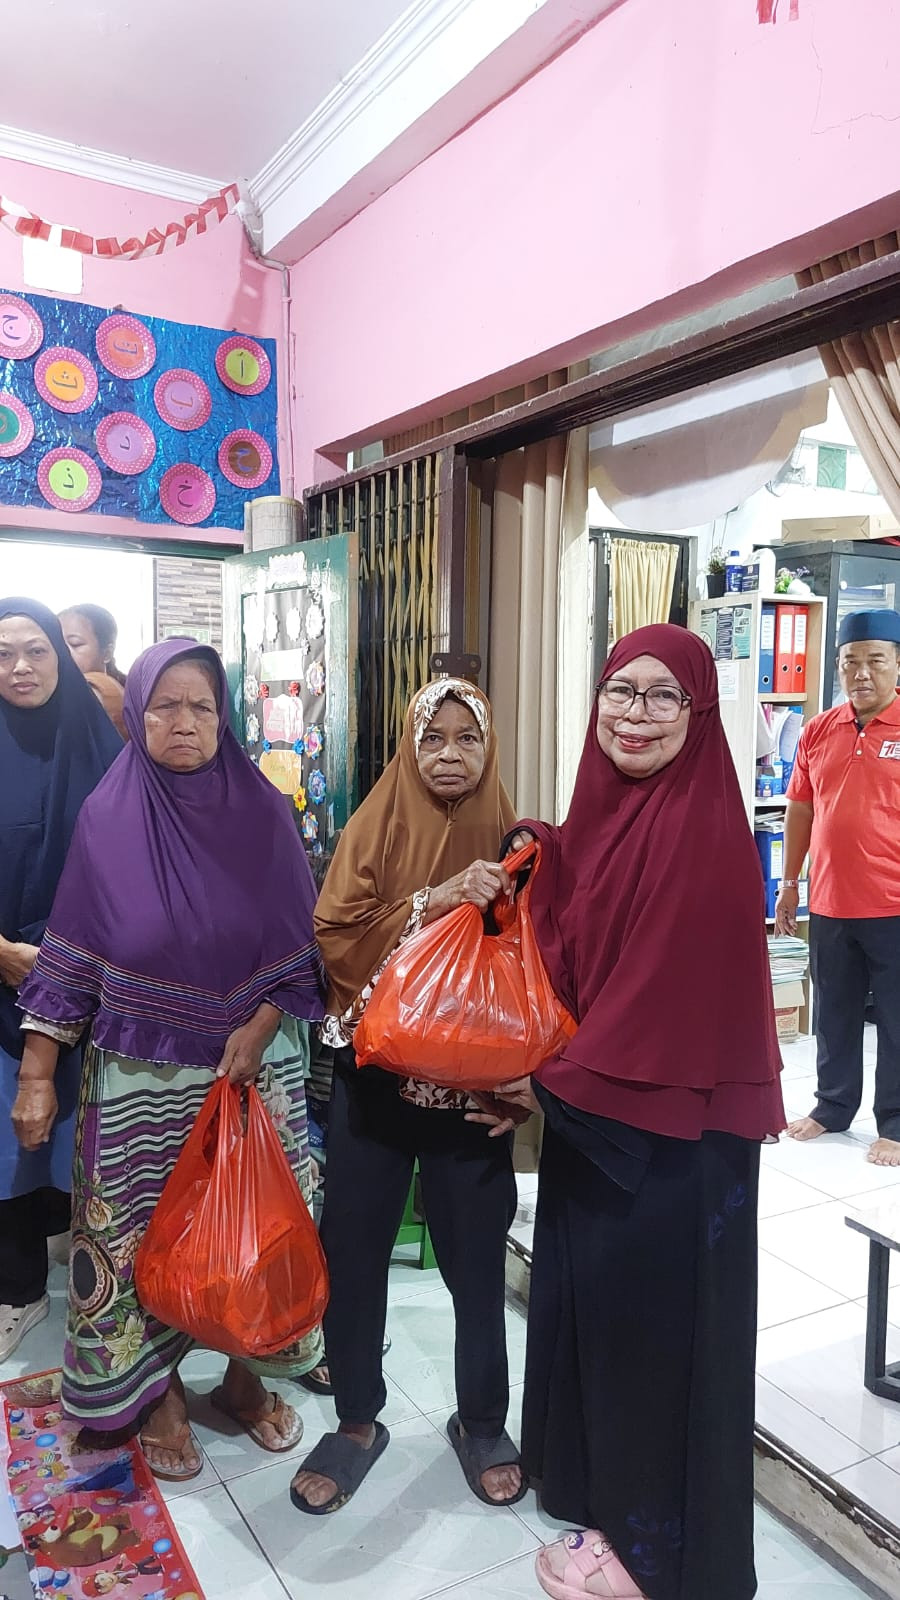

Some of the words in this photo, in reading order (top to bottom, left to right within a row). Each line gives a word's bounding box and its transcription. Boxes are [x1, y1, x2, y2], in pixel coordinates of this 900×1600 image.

[2, 314, 21, 340] ج
[52, 371, 78, 389] ث
[62, 467, 75, 489] ذ
[177, 480, 193, 508] خ
